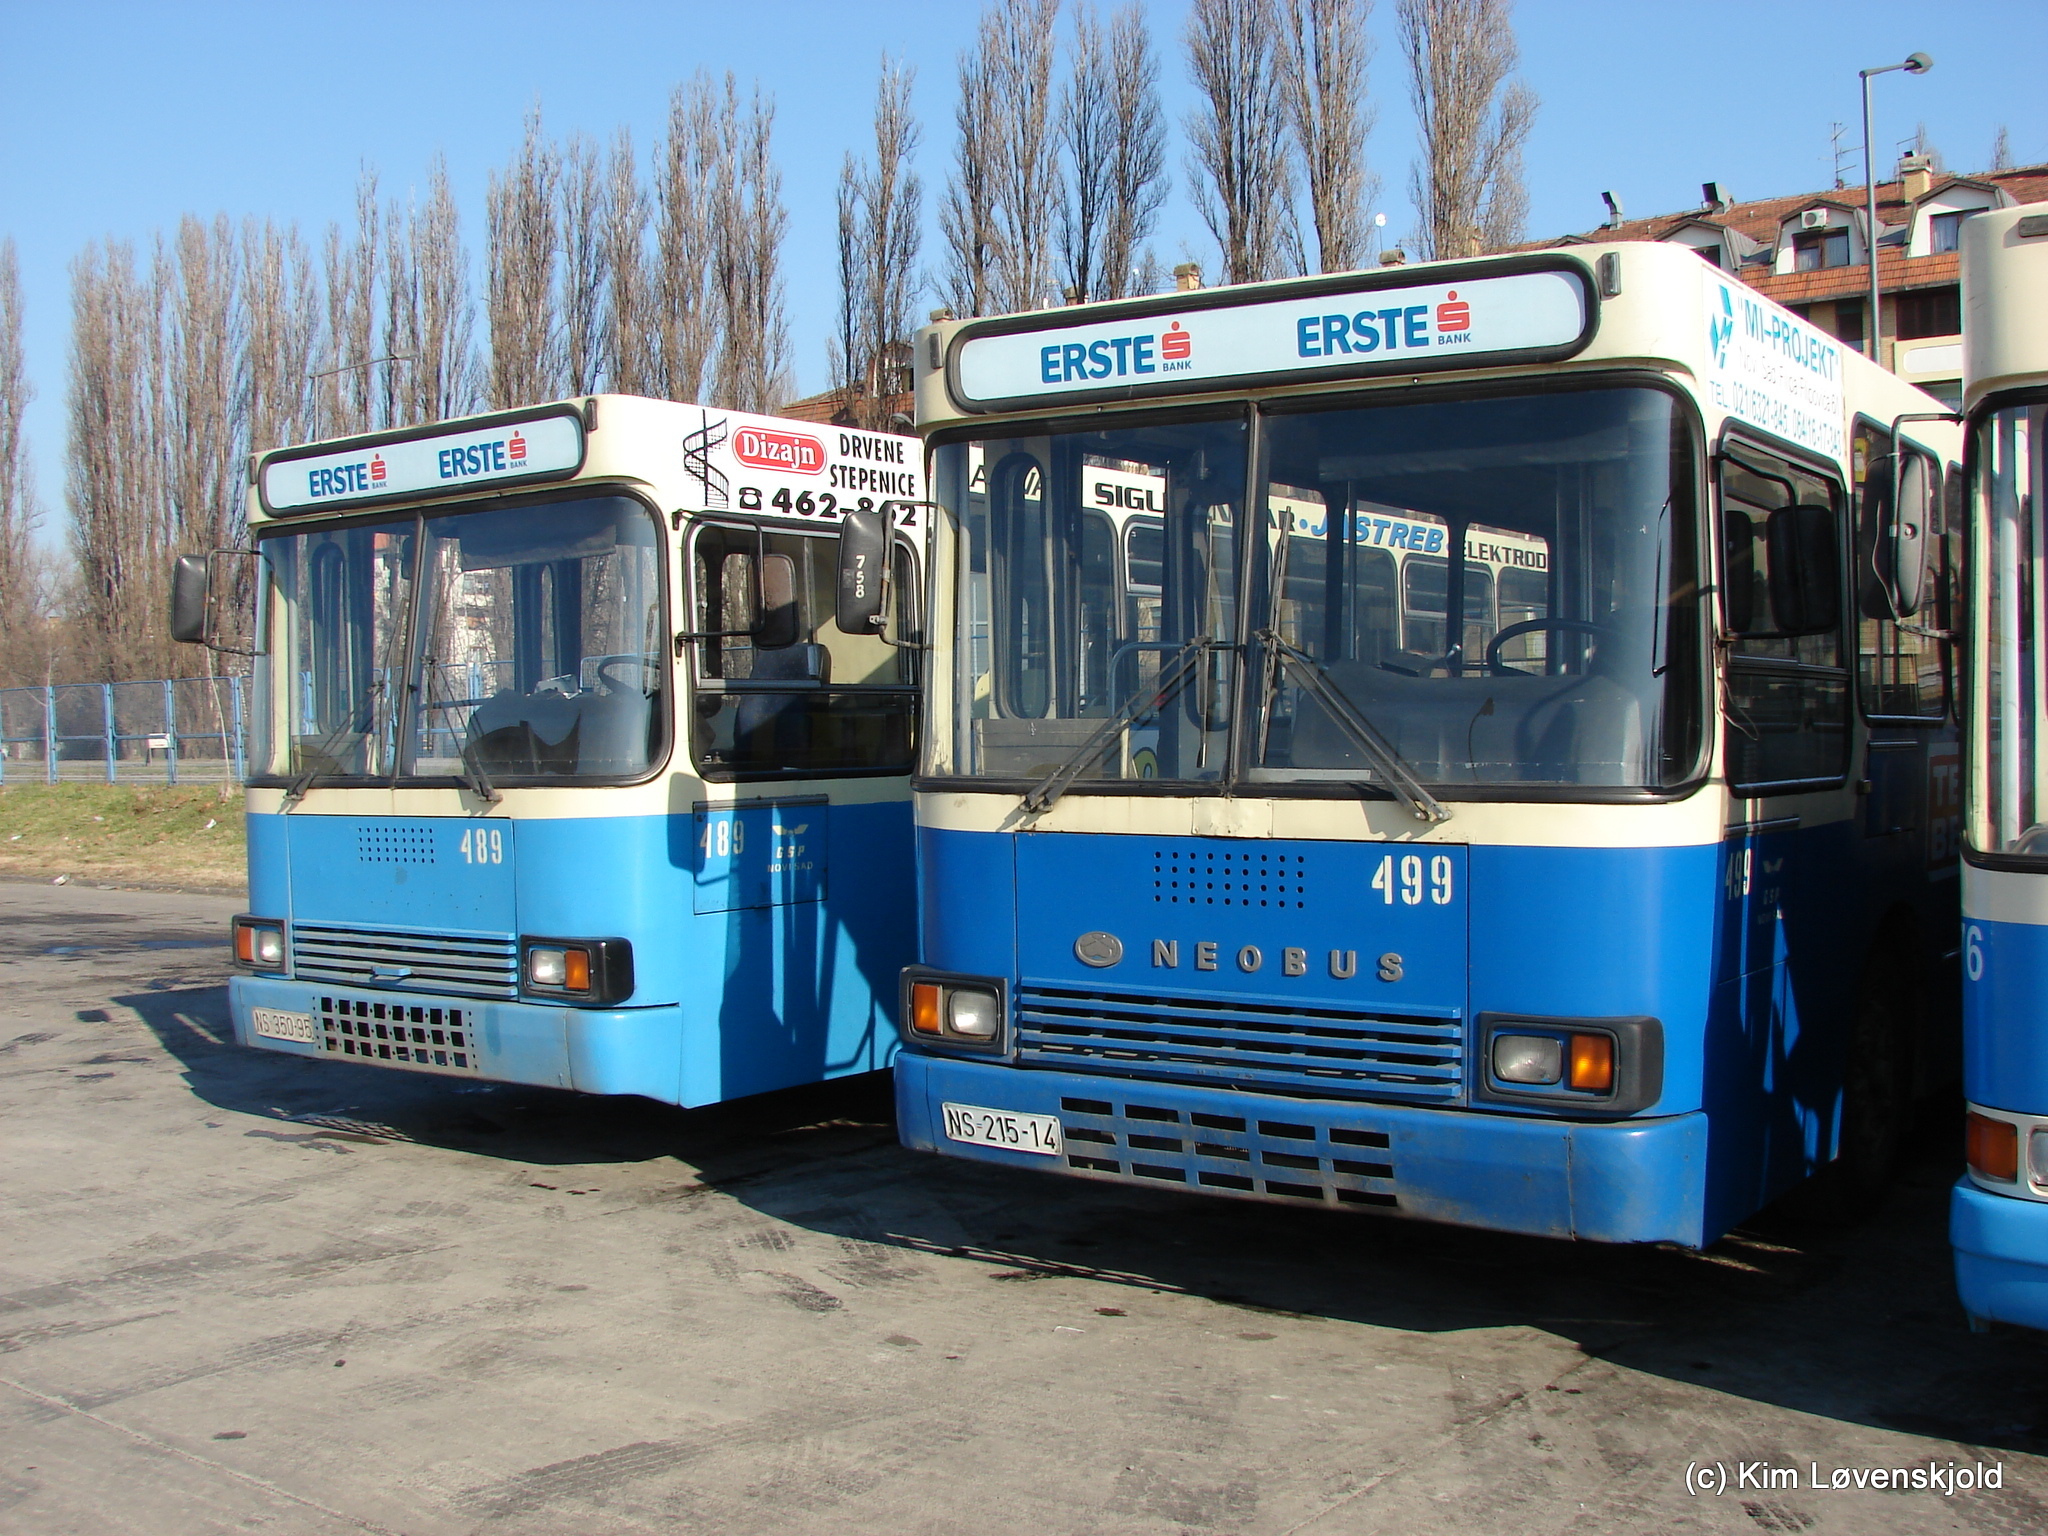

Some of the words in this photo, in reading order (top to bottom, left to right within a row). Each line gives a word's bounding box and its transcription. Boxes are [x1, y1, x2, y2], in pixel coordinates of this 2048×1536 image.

[1297, 306, 1429, 359] ERSTE
[1437, 333, 1472, 346] BANK
[1040, 335, 1156, 384] ERSTE
[1162, 359, 1193, 372] BANK
[438, 440, 506, 479] ERSTE
[509, 459, 528, 469] BANK
[740, 432, 816, 469] Dizajn
[839, 433, 905, 465] DRVENE
[308, 463, 368, 497] ERSTE
[371, 481, 388, 490] BANK
[829, 464, 916, 498] STEPENICE
[772, 487, 917, 527] 462-82
[1311, 513, 1444, 554] JSTREB
[1463, 540, 1547, 569] LEKTROD
[460, 828, 503, 864] 489
[700, 820, 744, 858] 489
[775, 845, 805, 859] GSP
[1370, 854, 1453, 905] 499
[1152, 938, 1404, 982] NEOBUS
[1961, 922, 1984, 982] 6
[254, 1010, 270, 1033] NS
[948, 1108, 975, 1138] NS
[982, 1114, 1057, 1149] 215-14
